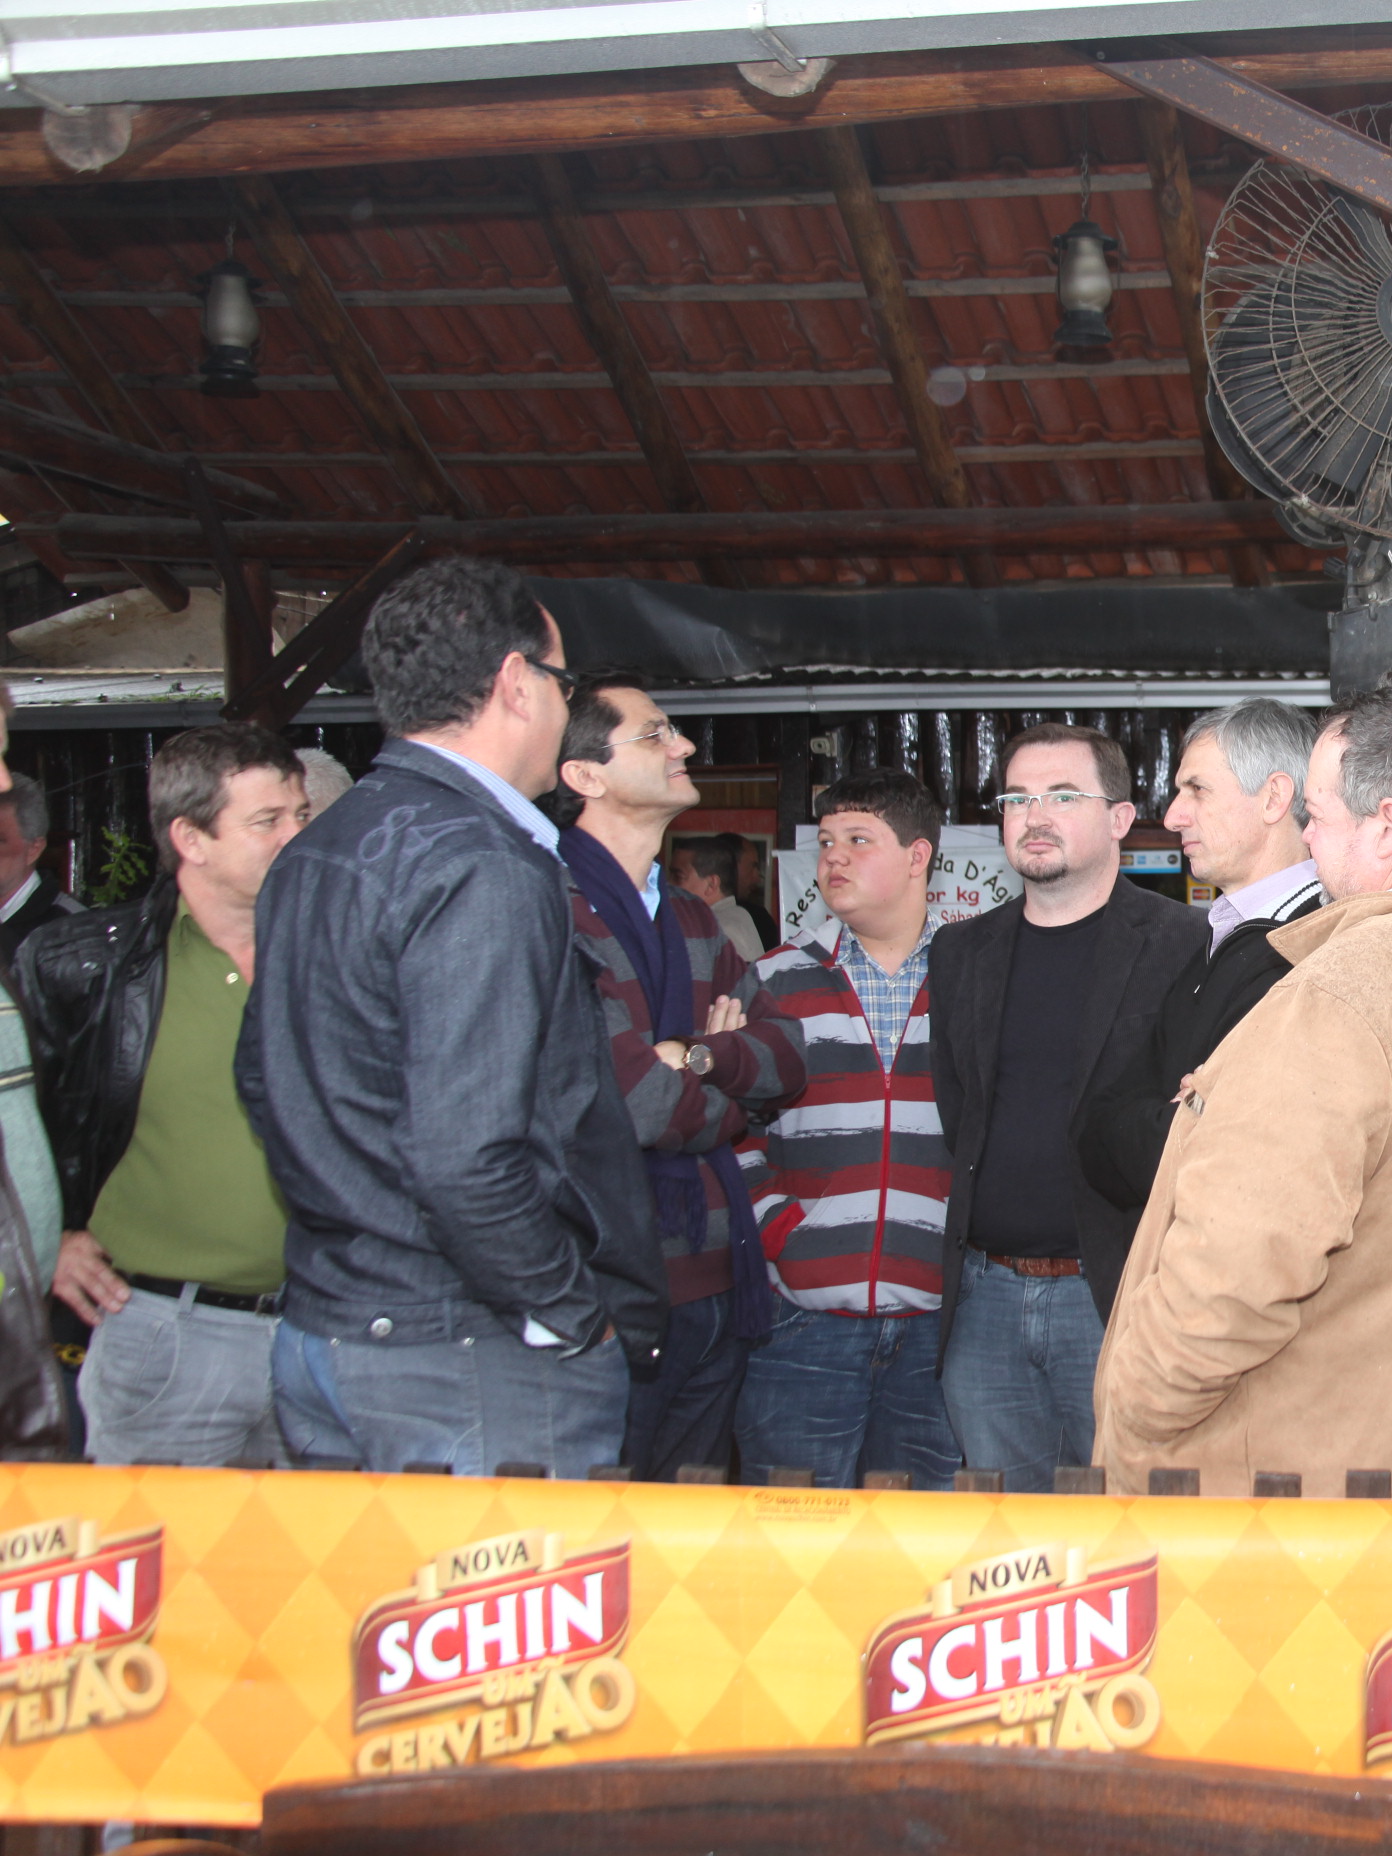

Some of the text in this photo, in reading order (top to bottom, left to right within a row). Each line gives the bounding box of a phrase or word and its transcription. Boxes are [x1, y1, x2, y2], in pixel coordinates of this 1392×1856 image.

[956, 885, 979, 906] kg
[450, 1538, 530, 1580] NOVA
[968, 1554, 1053, 1596] NOVA
[377, 1571, 605, 1696] SCHIN
[890, 1587, 1130, 1714] SCHIN
